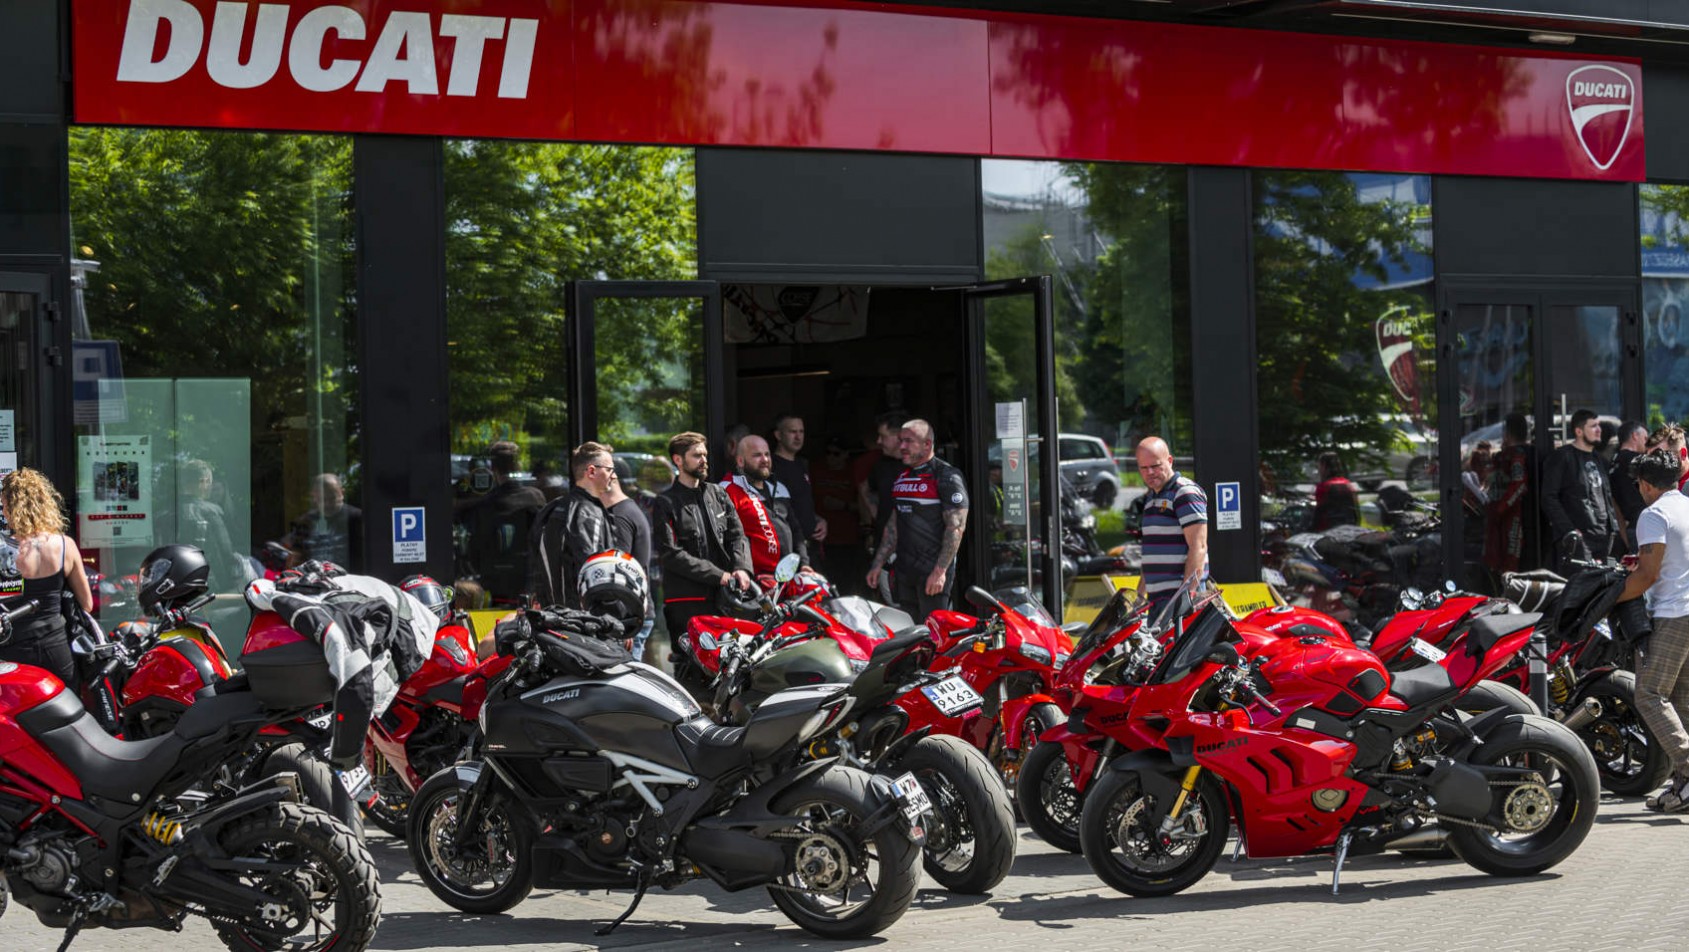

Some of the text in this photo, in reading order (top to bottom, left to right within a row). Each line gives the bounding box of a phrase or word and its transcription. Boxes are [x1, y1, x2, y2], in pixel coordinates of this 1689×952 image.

[116, 0, 539, 99] DUCATI
[1574, 81, 1627, 99] DUCATI
[1222, 487, 1234, 509] P
[401, 513, 416, 538] P
[542, 688, 580, 704] DUCATI
[936, 682, 956, 695] WU
[938, 690, 974, 708] 9163
[1196, 736, 1249, 754] DUCATI
